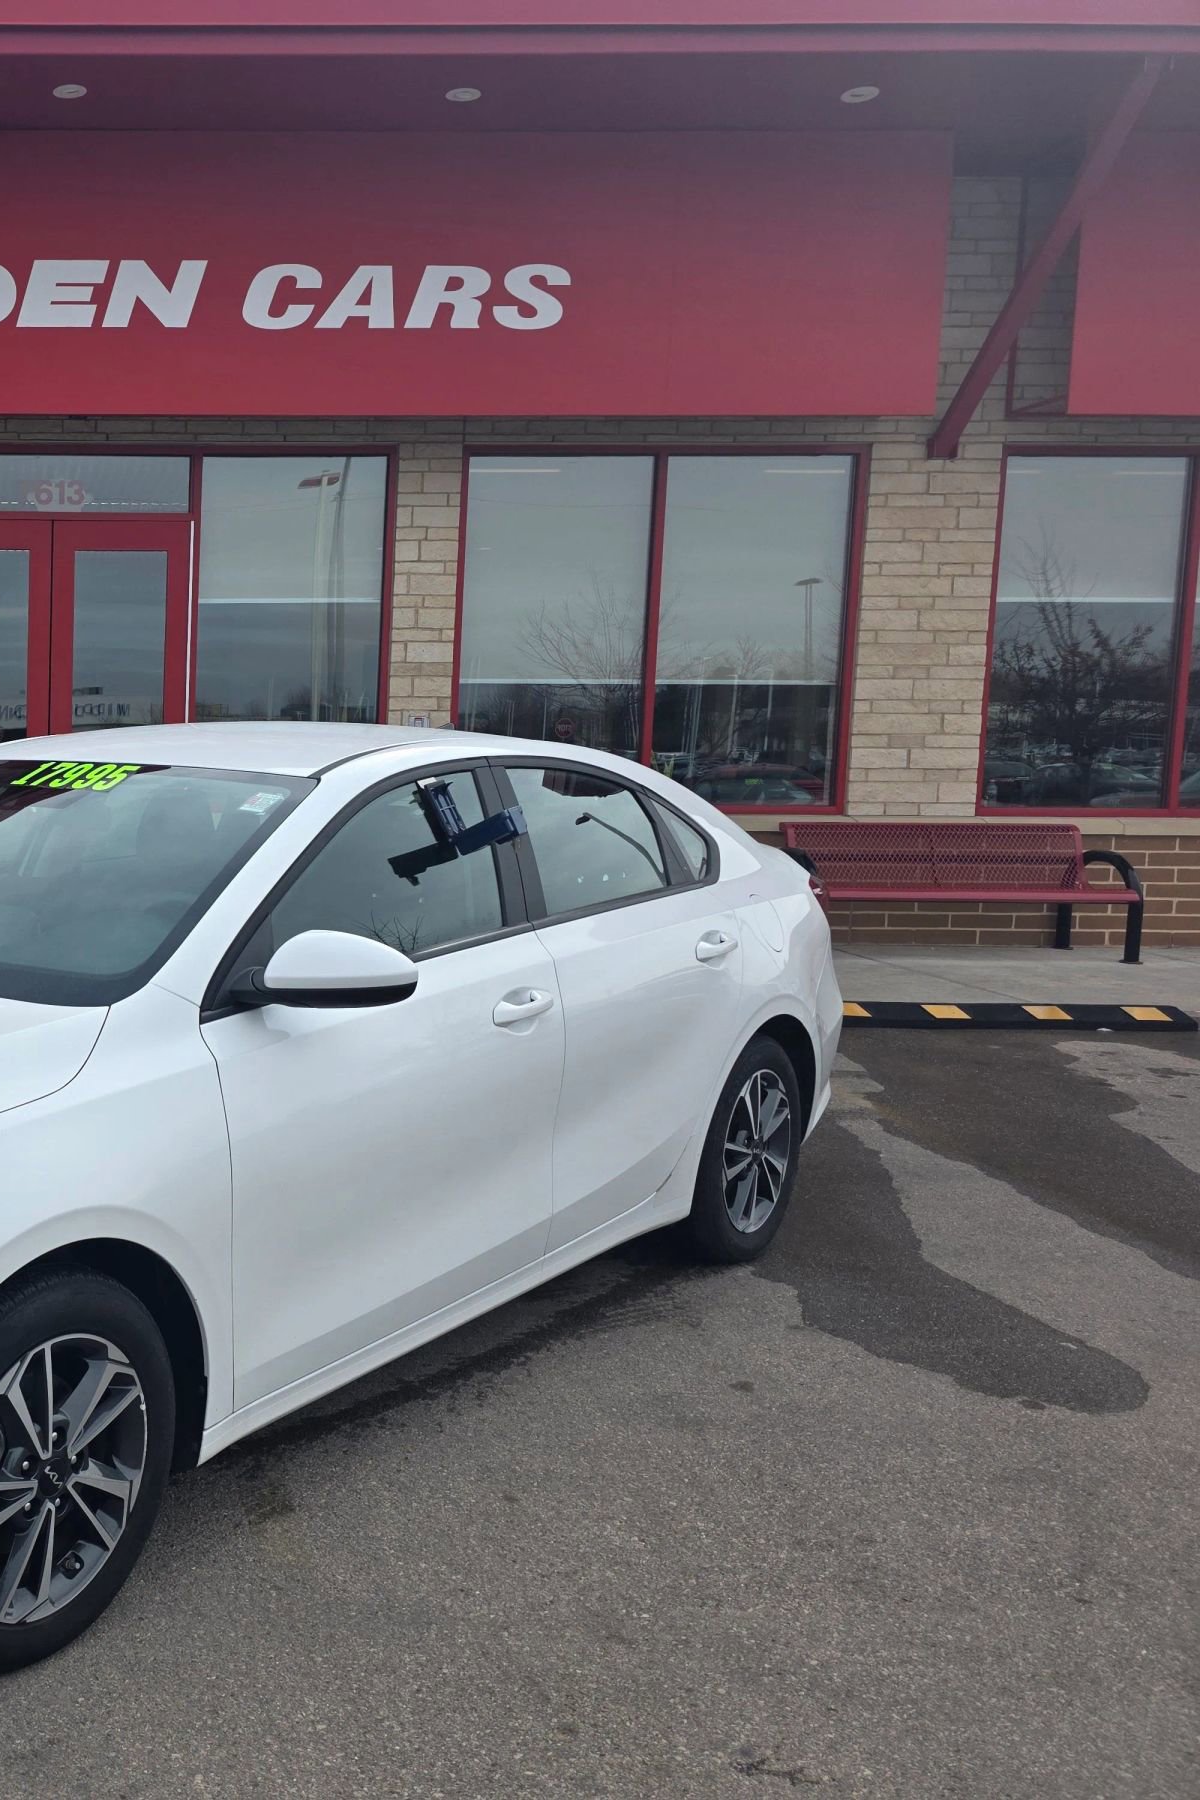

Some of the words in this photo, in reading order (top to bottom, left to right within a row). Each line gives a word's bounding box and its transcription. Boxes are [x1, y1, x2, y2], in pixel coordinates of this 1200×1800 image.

[241, 263, 572, 330] CARS
[35, 480, 85, 505] 613
[9, 761, 141, 791] 17995
